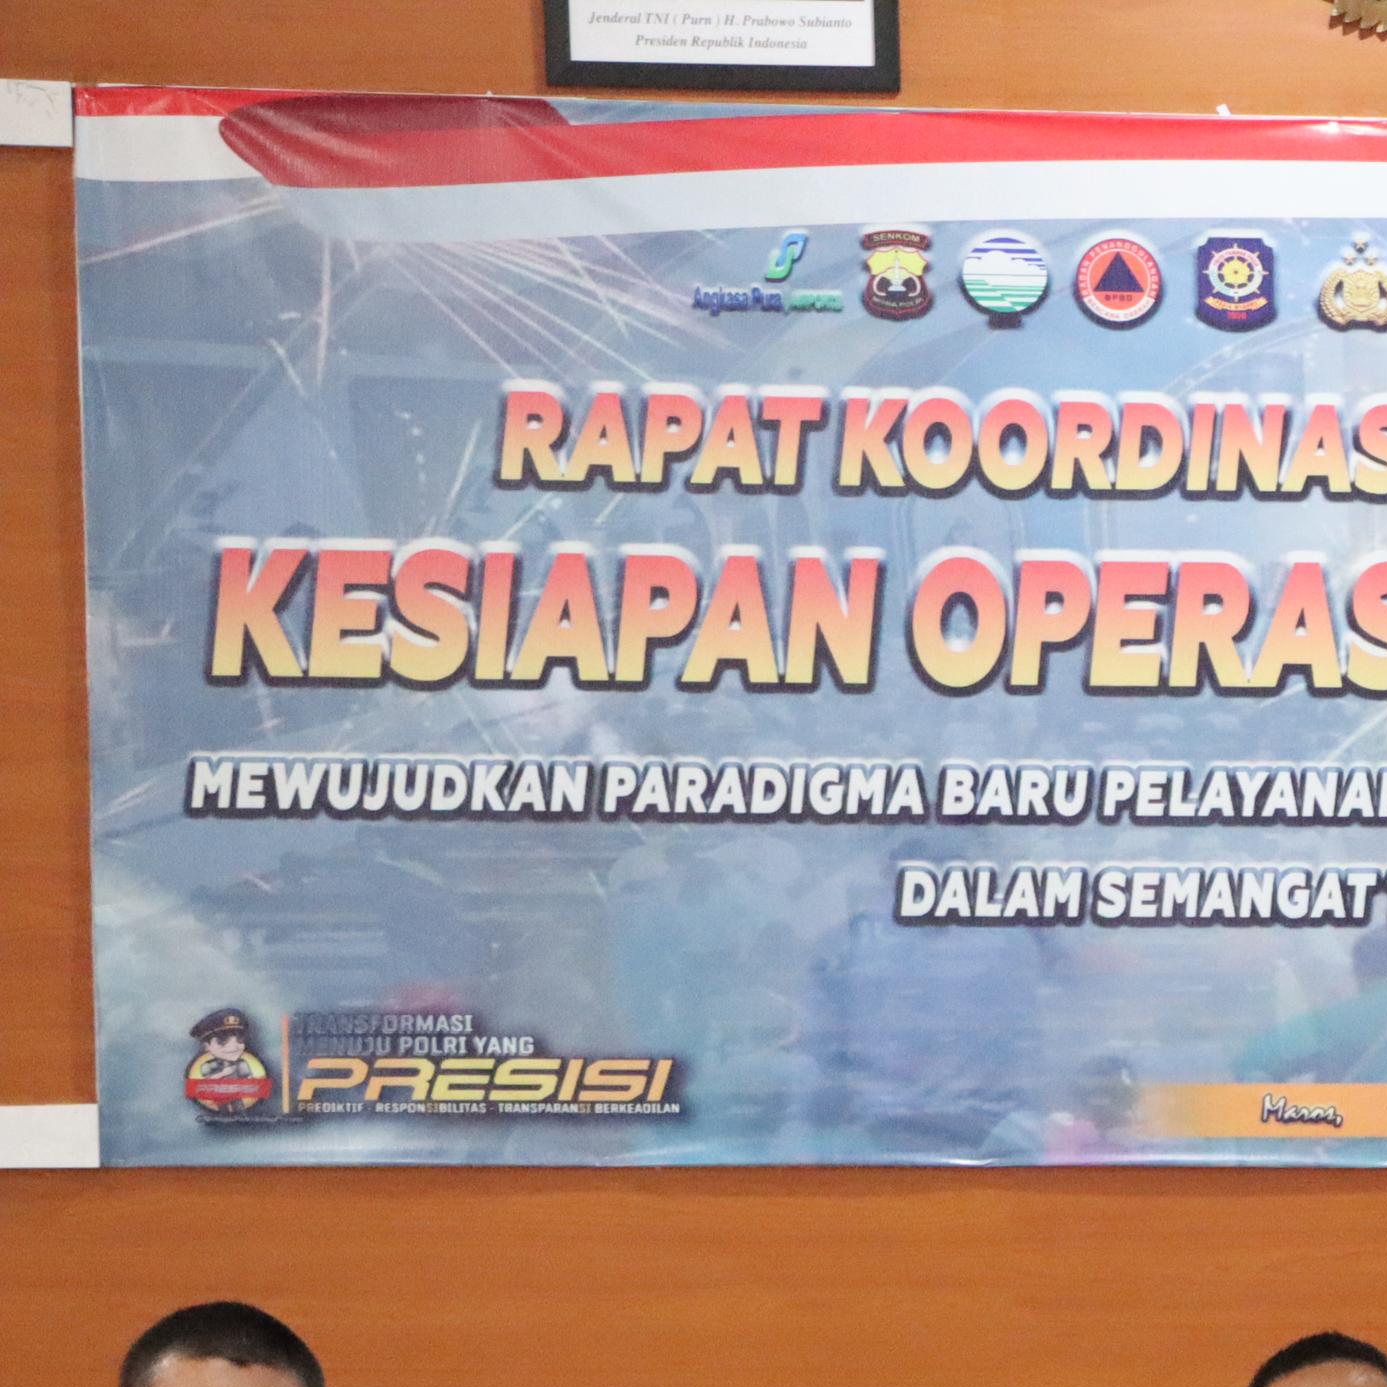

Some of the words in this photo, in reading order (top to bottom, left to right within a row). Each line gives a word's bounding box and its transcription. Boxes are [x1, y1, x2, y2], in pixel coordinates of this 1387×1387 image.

[587, 11, 641, 25] Jenderal
[645, 12, 670, 25] TNI
[682, 13, 712, 26] Purn
[724, 14, 740, 27] H.
[742, 15, 796, 28] Prabowo
[799, 15, 853, 29] Subianto
[635, 34, 687, 48] Presiden
[691, 35, 744, 50] Republik
[748, 36, 808, 49] Indonesia
[872, 232, 922, 242] SENKOM
[693, 286, 749, 316] Angkasa
[752, 286, 785, 312] Pura
[498, 390, 824, 486] RAPAT
[209, 546, 880, 687] KESIAPAN
[189, 761, 591, 812] MEWUJUDKAN
[603, 766, 926, 816] PARADIGMA
[944, 768, 1089, 817] BARU
[900, 870, 1084, 918] DALAM
[1098, 870, 1378, 920] SEMANGAT
[299, 1014, 473, 1034] TRANSFORMASI
[301, 1036, 391, 1056] MENUJU
[400, 1036, 467, 1056] POLRI
[472, 1036, 535, 1056] YANG
[297, 1057, 673, 1101] PRESISI
[299, 1102, 364, 1114] PREDIKTIF
[375, 1102, 487, 1114] RESPONSIBILITAS
[498, 1103, 591, 1114] TRANSPARANSI
[594, 1103, 680, 1114] BERKEADILAN
[1261, 1092, 1343, 1127] Maros,
